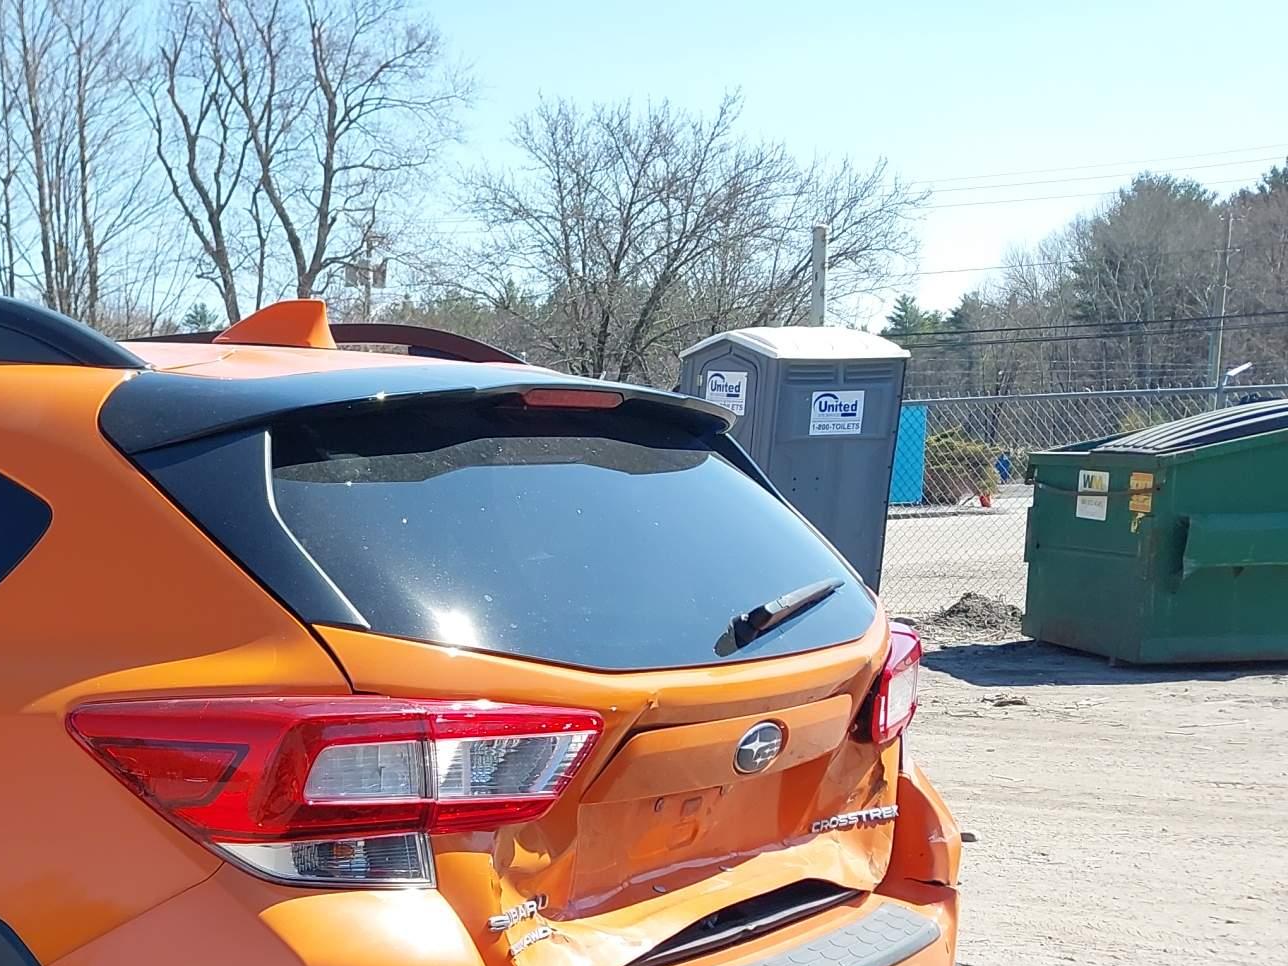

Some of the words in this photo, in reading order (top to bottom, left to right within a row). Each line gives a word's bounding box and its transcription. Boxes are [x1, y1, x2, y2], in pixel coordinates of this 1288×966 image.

[710, 379, 741, 393] United
[818, 400, 858, 413] United
[1083, 473, 1104, 490] WM
[811, 804, 900, 833] CROSSTREK
